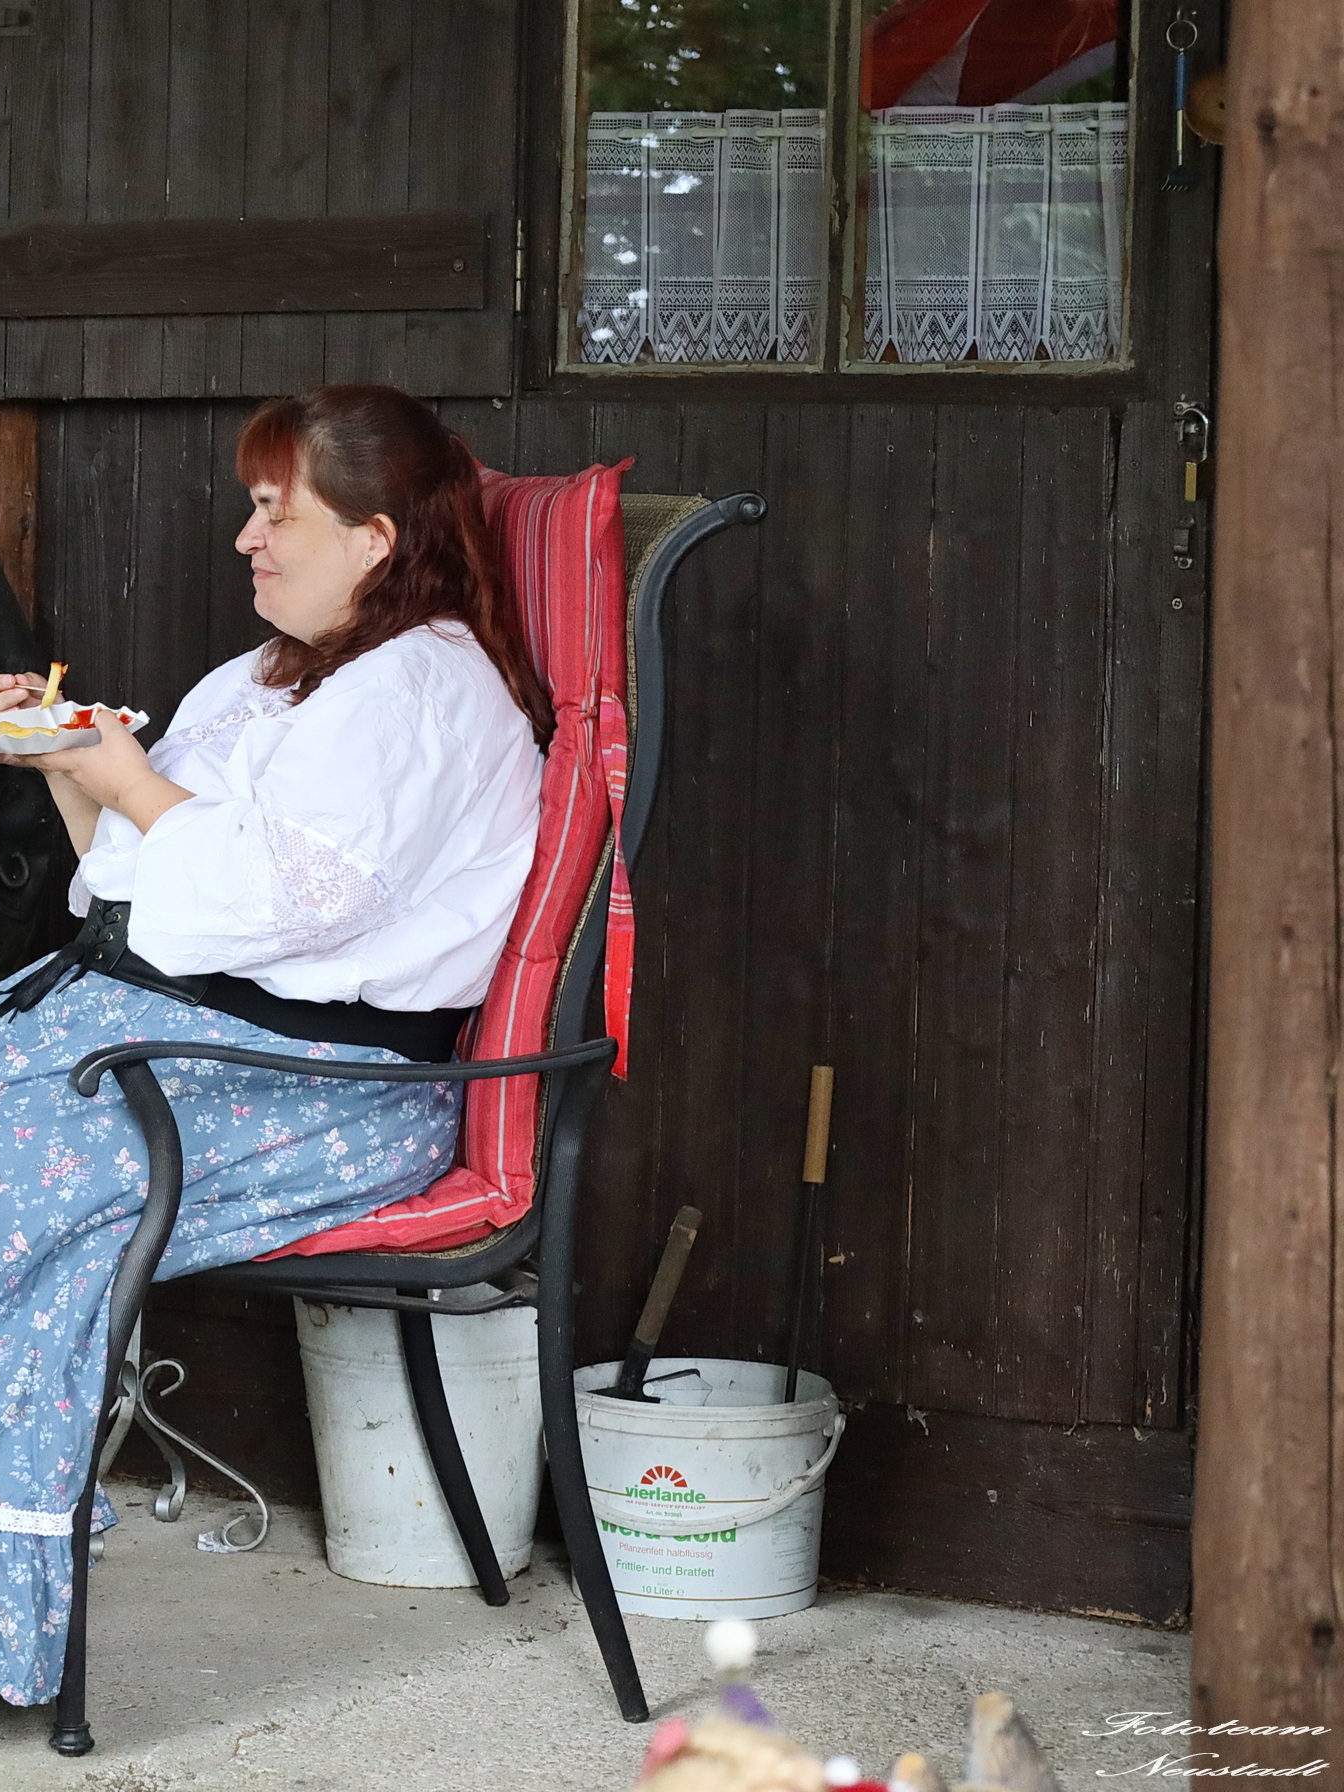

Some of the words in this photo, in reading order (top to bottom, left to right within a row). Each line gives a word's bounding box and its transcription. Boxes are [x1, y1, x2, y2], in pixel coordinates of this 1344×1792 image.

[625, 1485, 706, 1503] vierlande
[618, 1541, 664, 1556] Pflanzenfett
[666, 1548, 713, 1560] halbflüssig
[616, 1558, 649, 1572] Frittier-
[652, 1565, 672, 1575] und
[676, 1565, 715, 1577] Bratfett
[641, 1585, 652, 1594] 10
[654, 1586, 674, 1596] Liter
